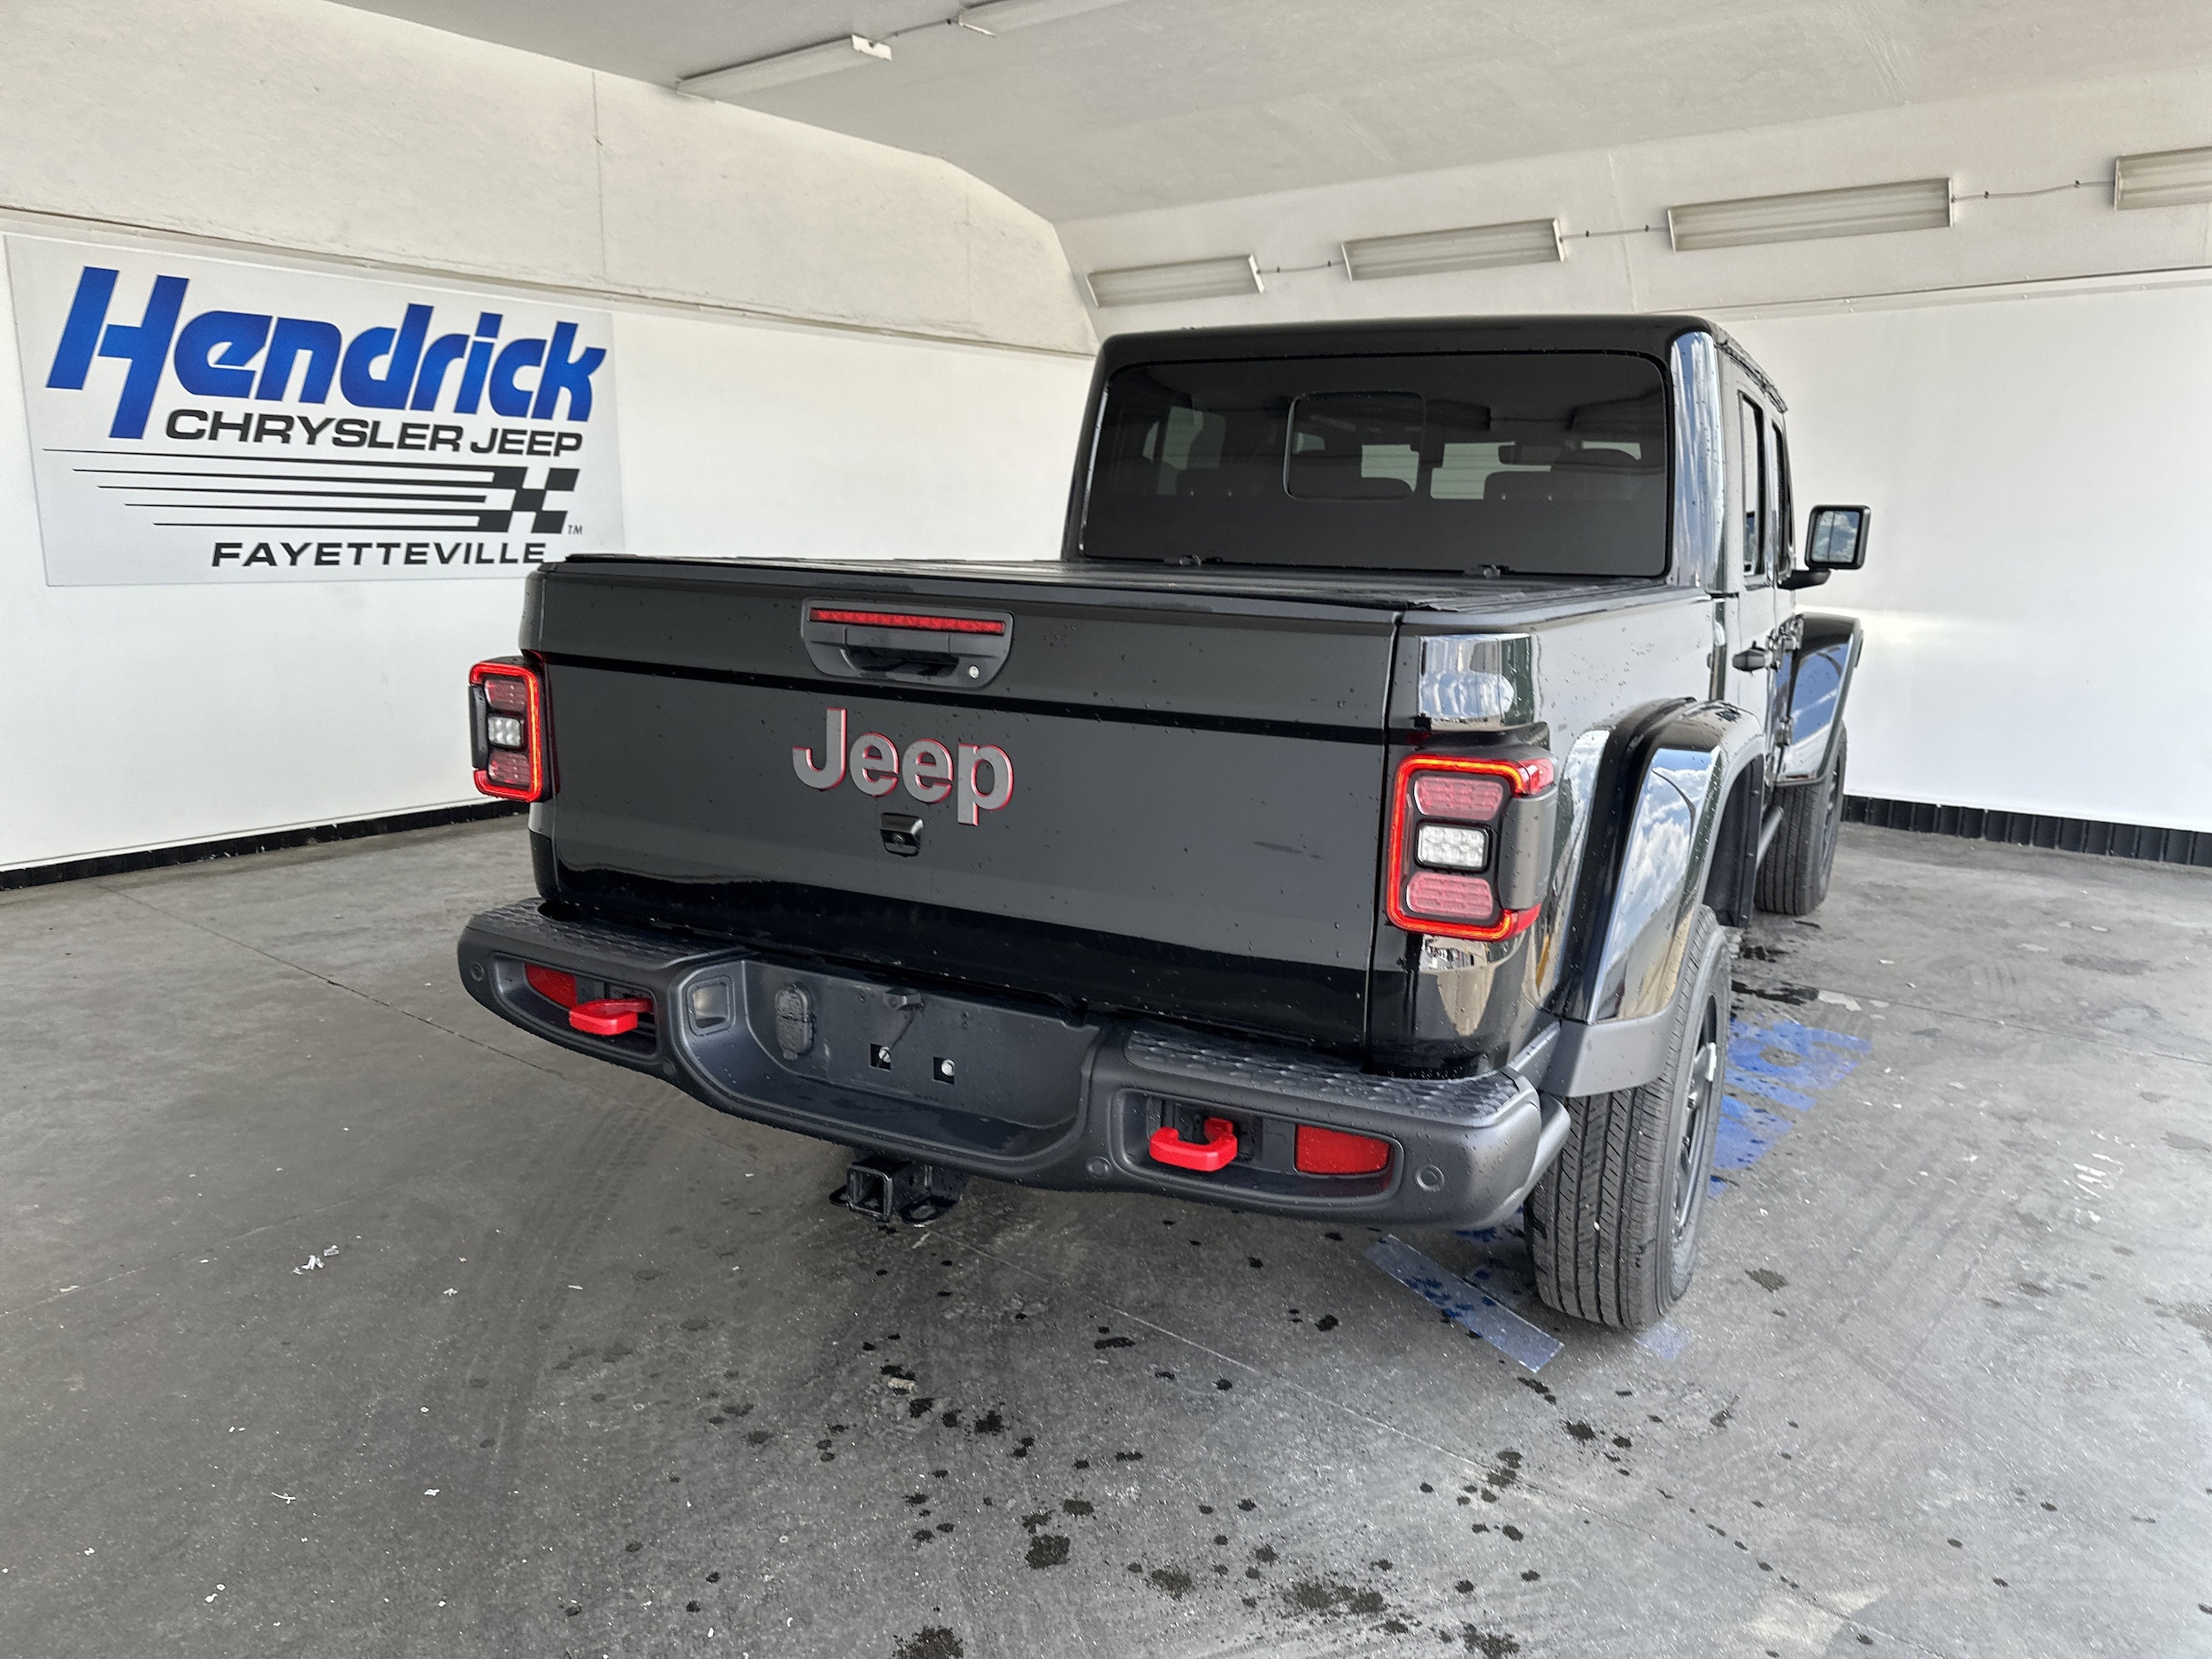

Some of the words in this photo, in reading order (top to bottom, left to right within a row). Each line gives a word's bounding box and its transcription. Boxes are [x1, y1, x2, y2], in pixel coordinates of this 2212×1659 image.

[46, 265, 606, 439] Hendrick
[165, 409, 464, 453] CHRYSLER
[470, 427, 583, 457] JEEP
[211, 541, 546, 567] FAYETTEVILLE
[793, 708, 1014, 826] Jeep
